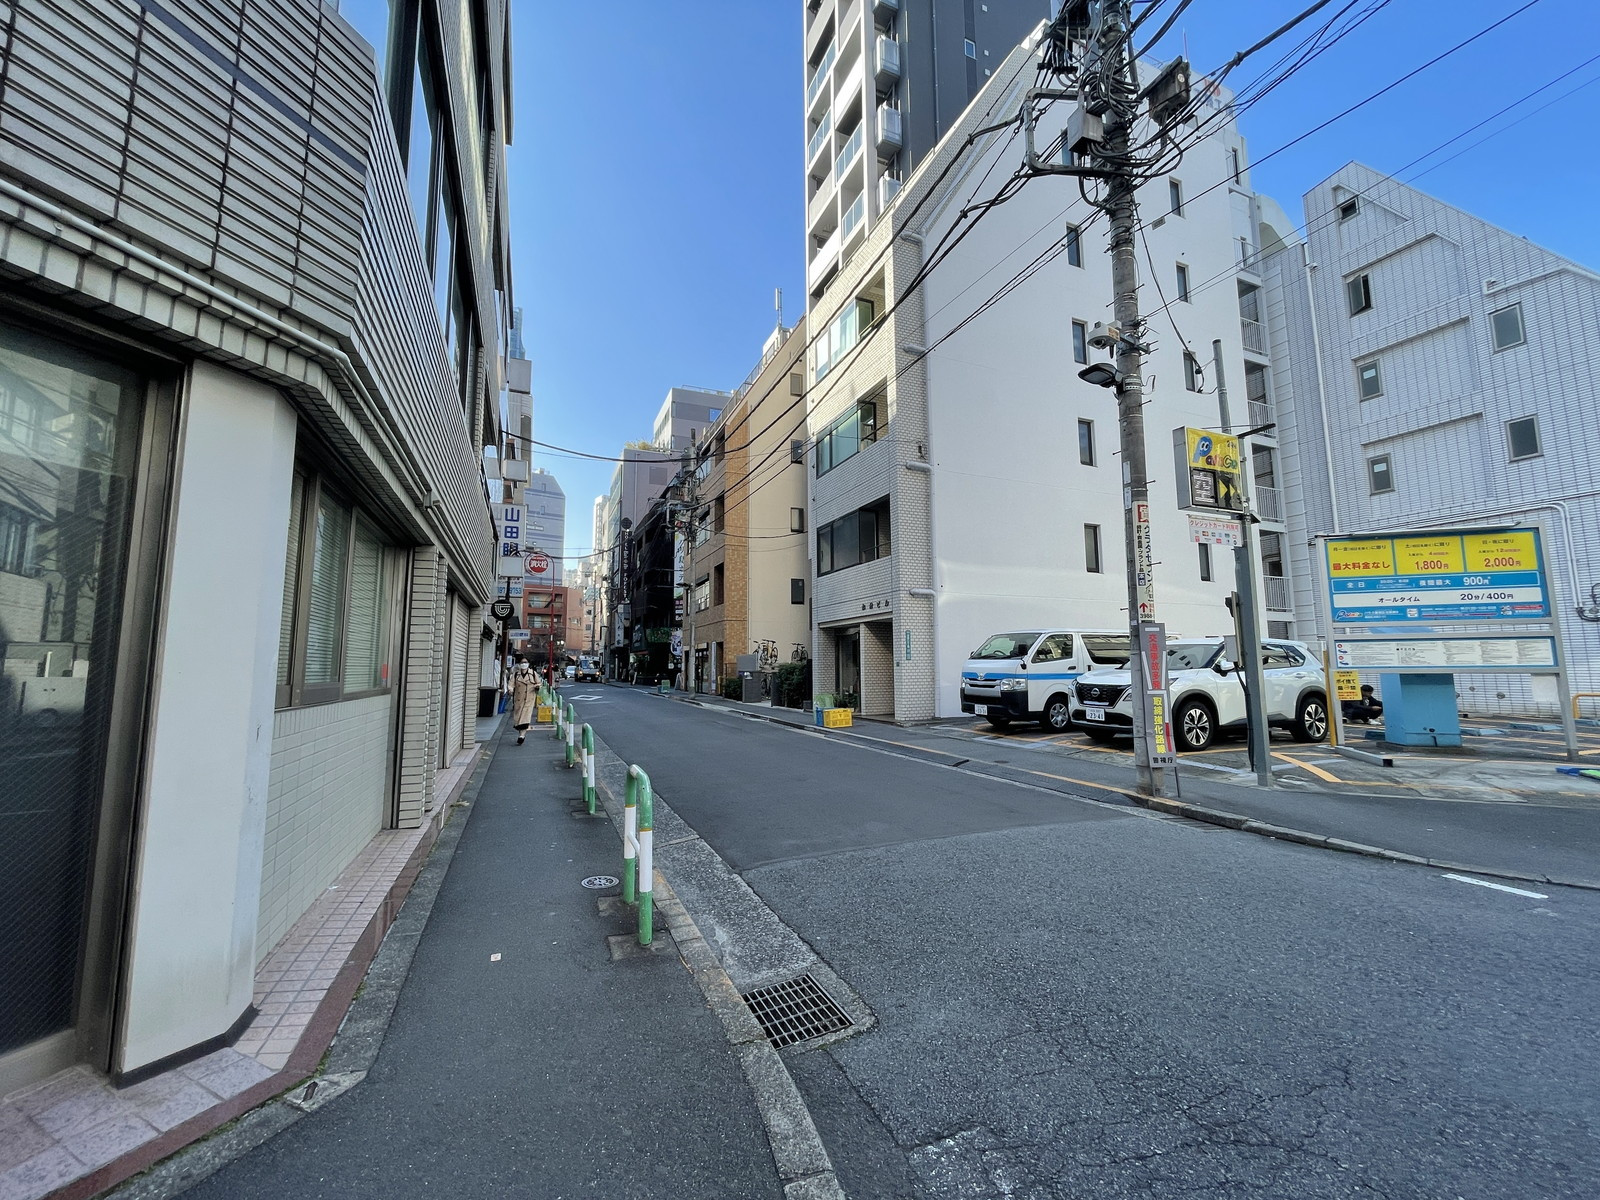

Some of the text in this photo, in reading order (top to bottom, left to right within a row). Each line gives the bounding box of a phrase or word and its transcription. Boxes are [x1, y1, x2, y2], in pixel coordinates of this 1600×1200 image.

[530, 560, 547, 568] 消火栓
[1332, 561, 1391, 571] 最大料金なし
[1415, 560, 1449, 571] 1,800円
[1484, 557, 1521, 568] 2,000円
[1378, 596, 1421, 604] オールタイム
[1148, 633, 1161, 690] 交通事故多発
[1152, 696, 1167, 754] 取締強化路線
